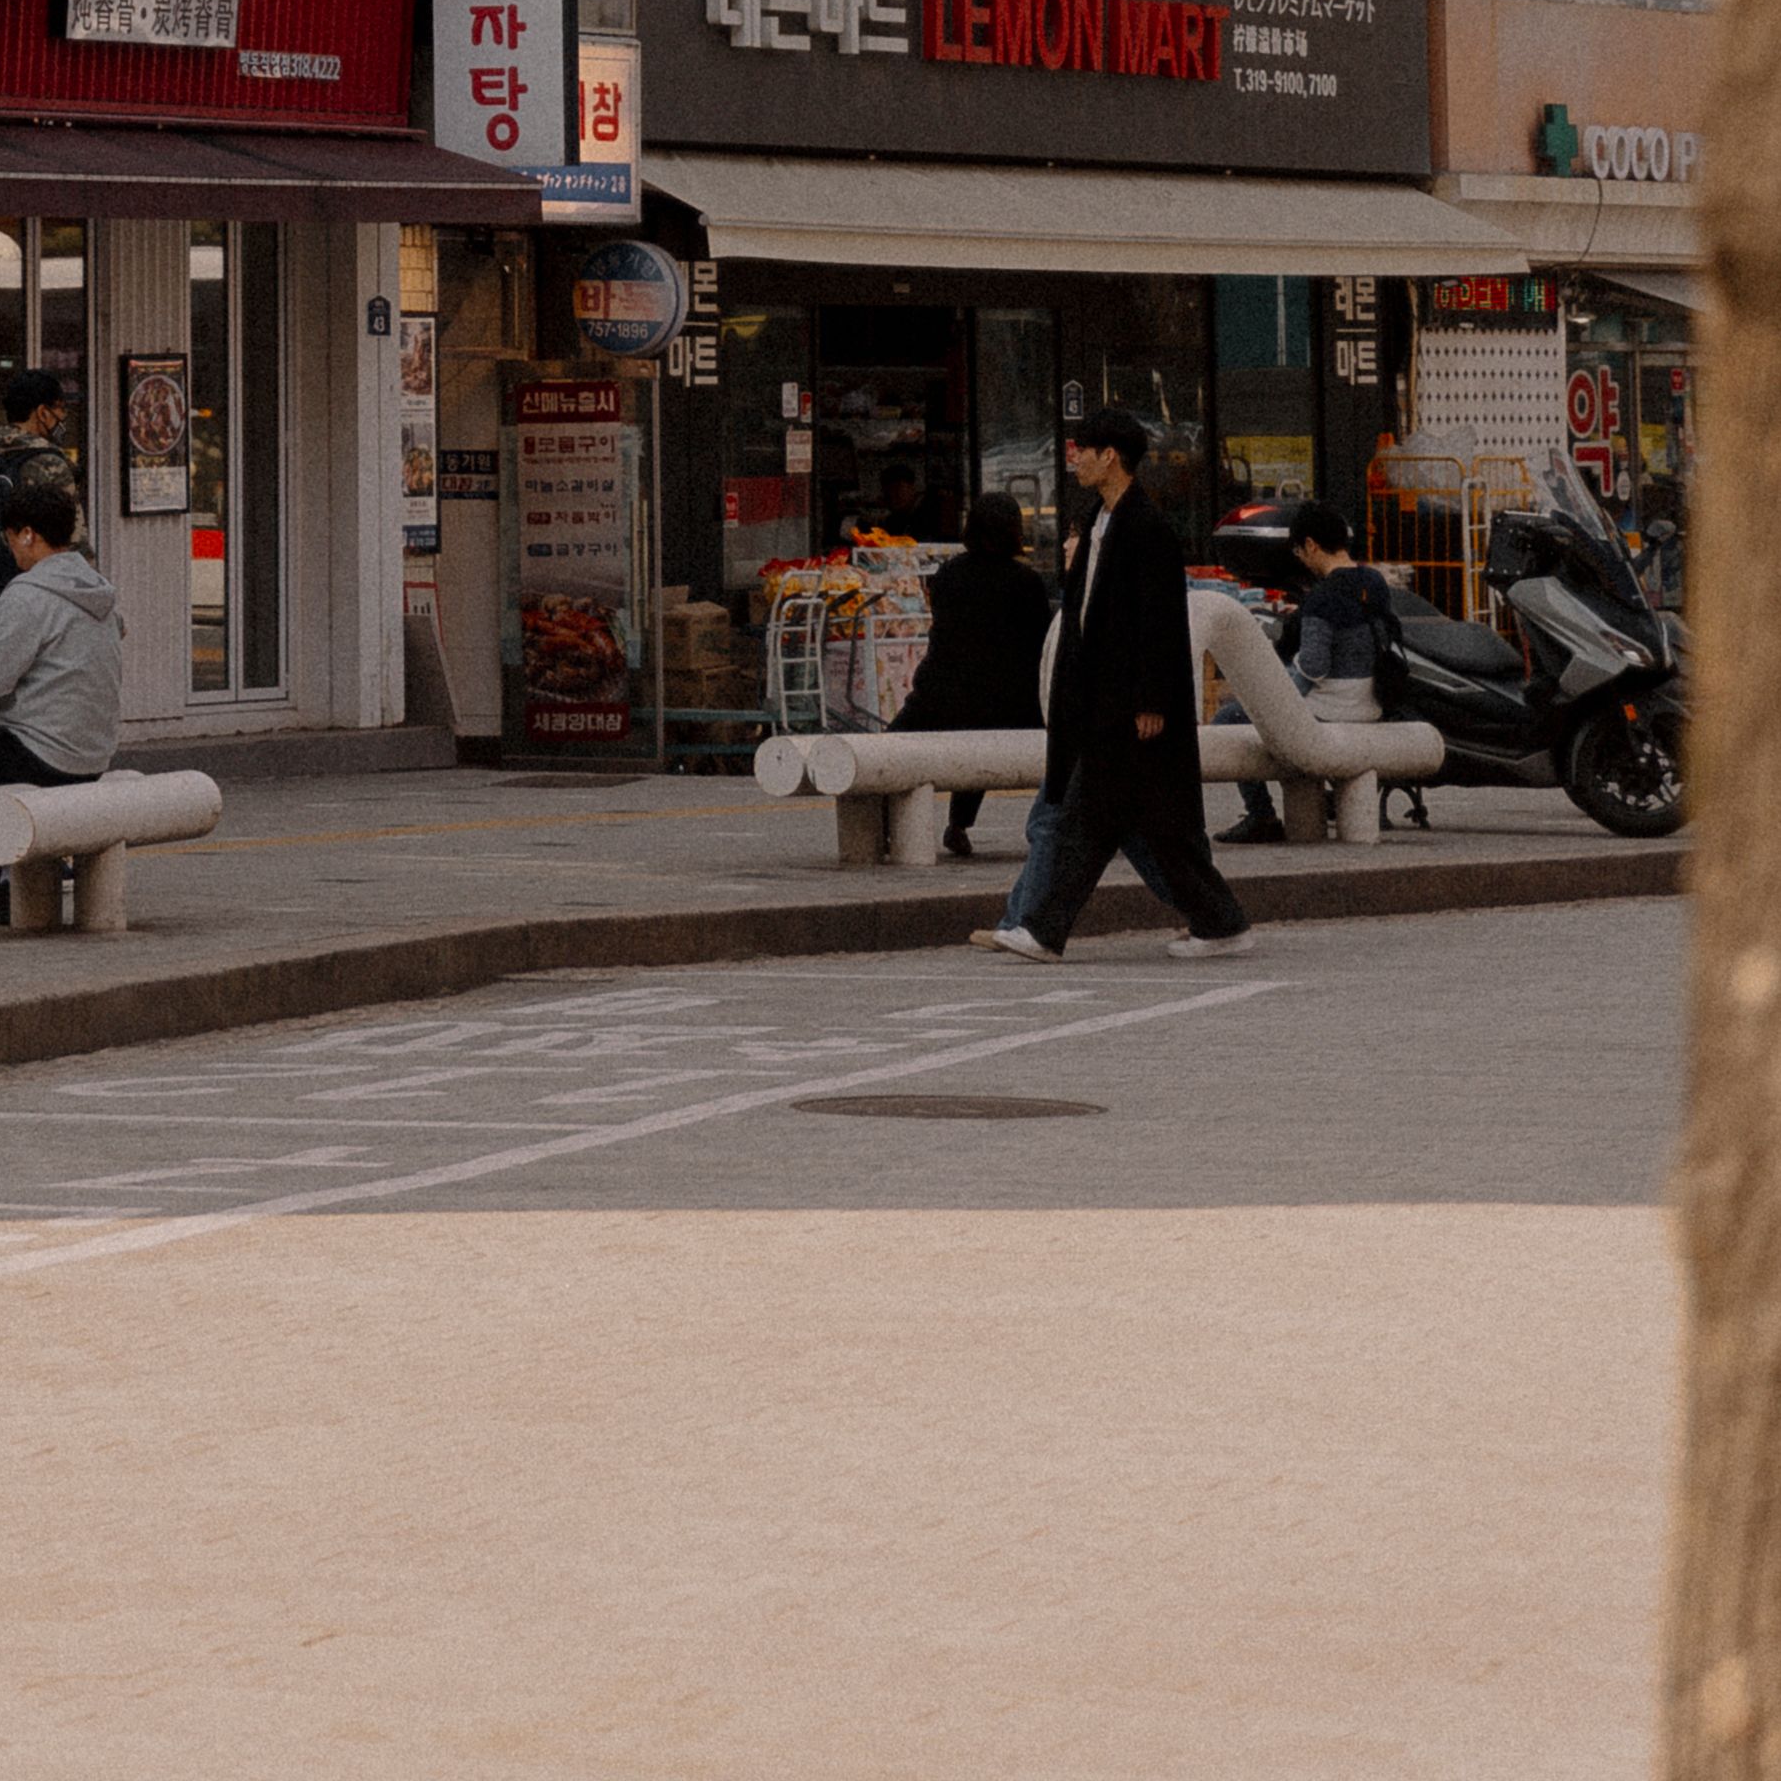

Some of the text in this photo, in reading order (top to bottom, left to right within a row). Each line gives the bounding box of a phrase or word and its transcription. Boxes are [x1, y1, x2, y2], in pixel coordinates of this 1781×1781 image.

[1584, 125, 1669, 181] COCO
[668, 335, 719, 388] 마트
[1334, 339, 1379, 386] 마트
[1568, 365, 1620, 498] 약
[440, 450, 493, 472] 동기원
